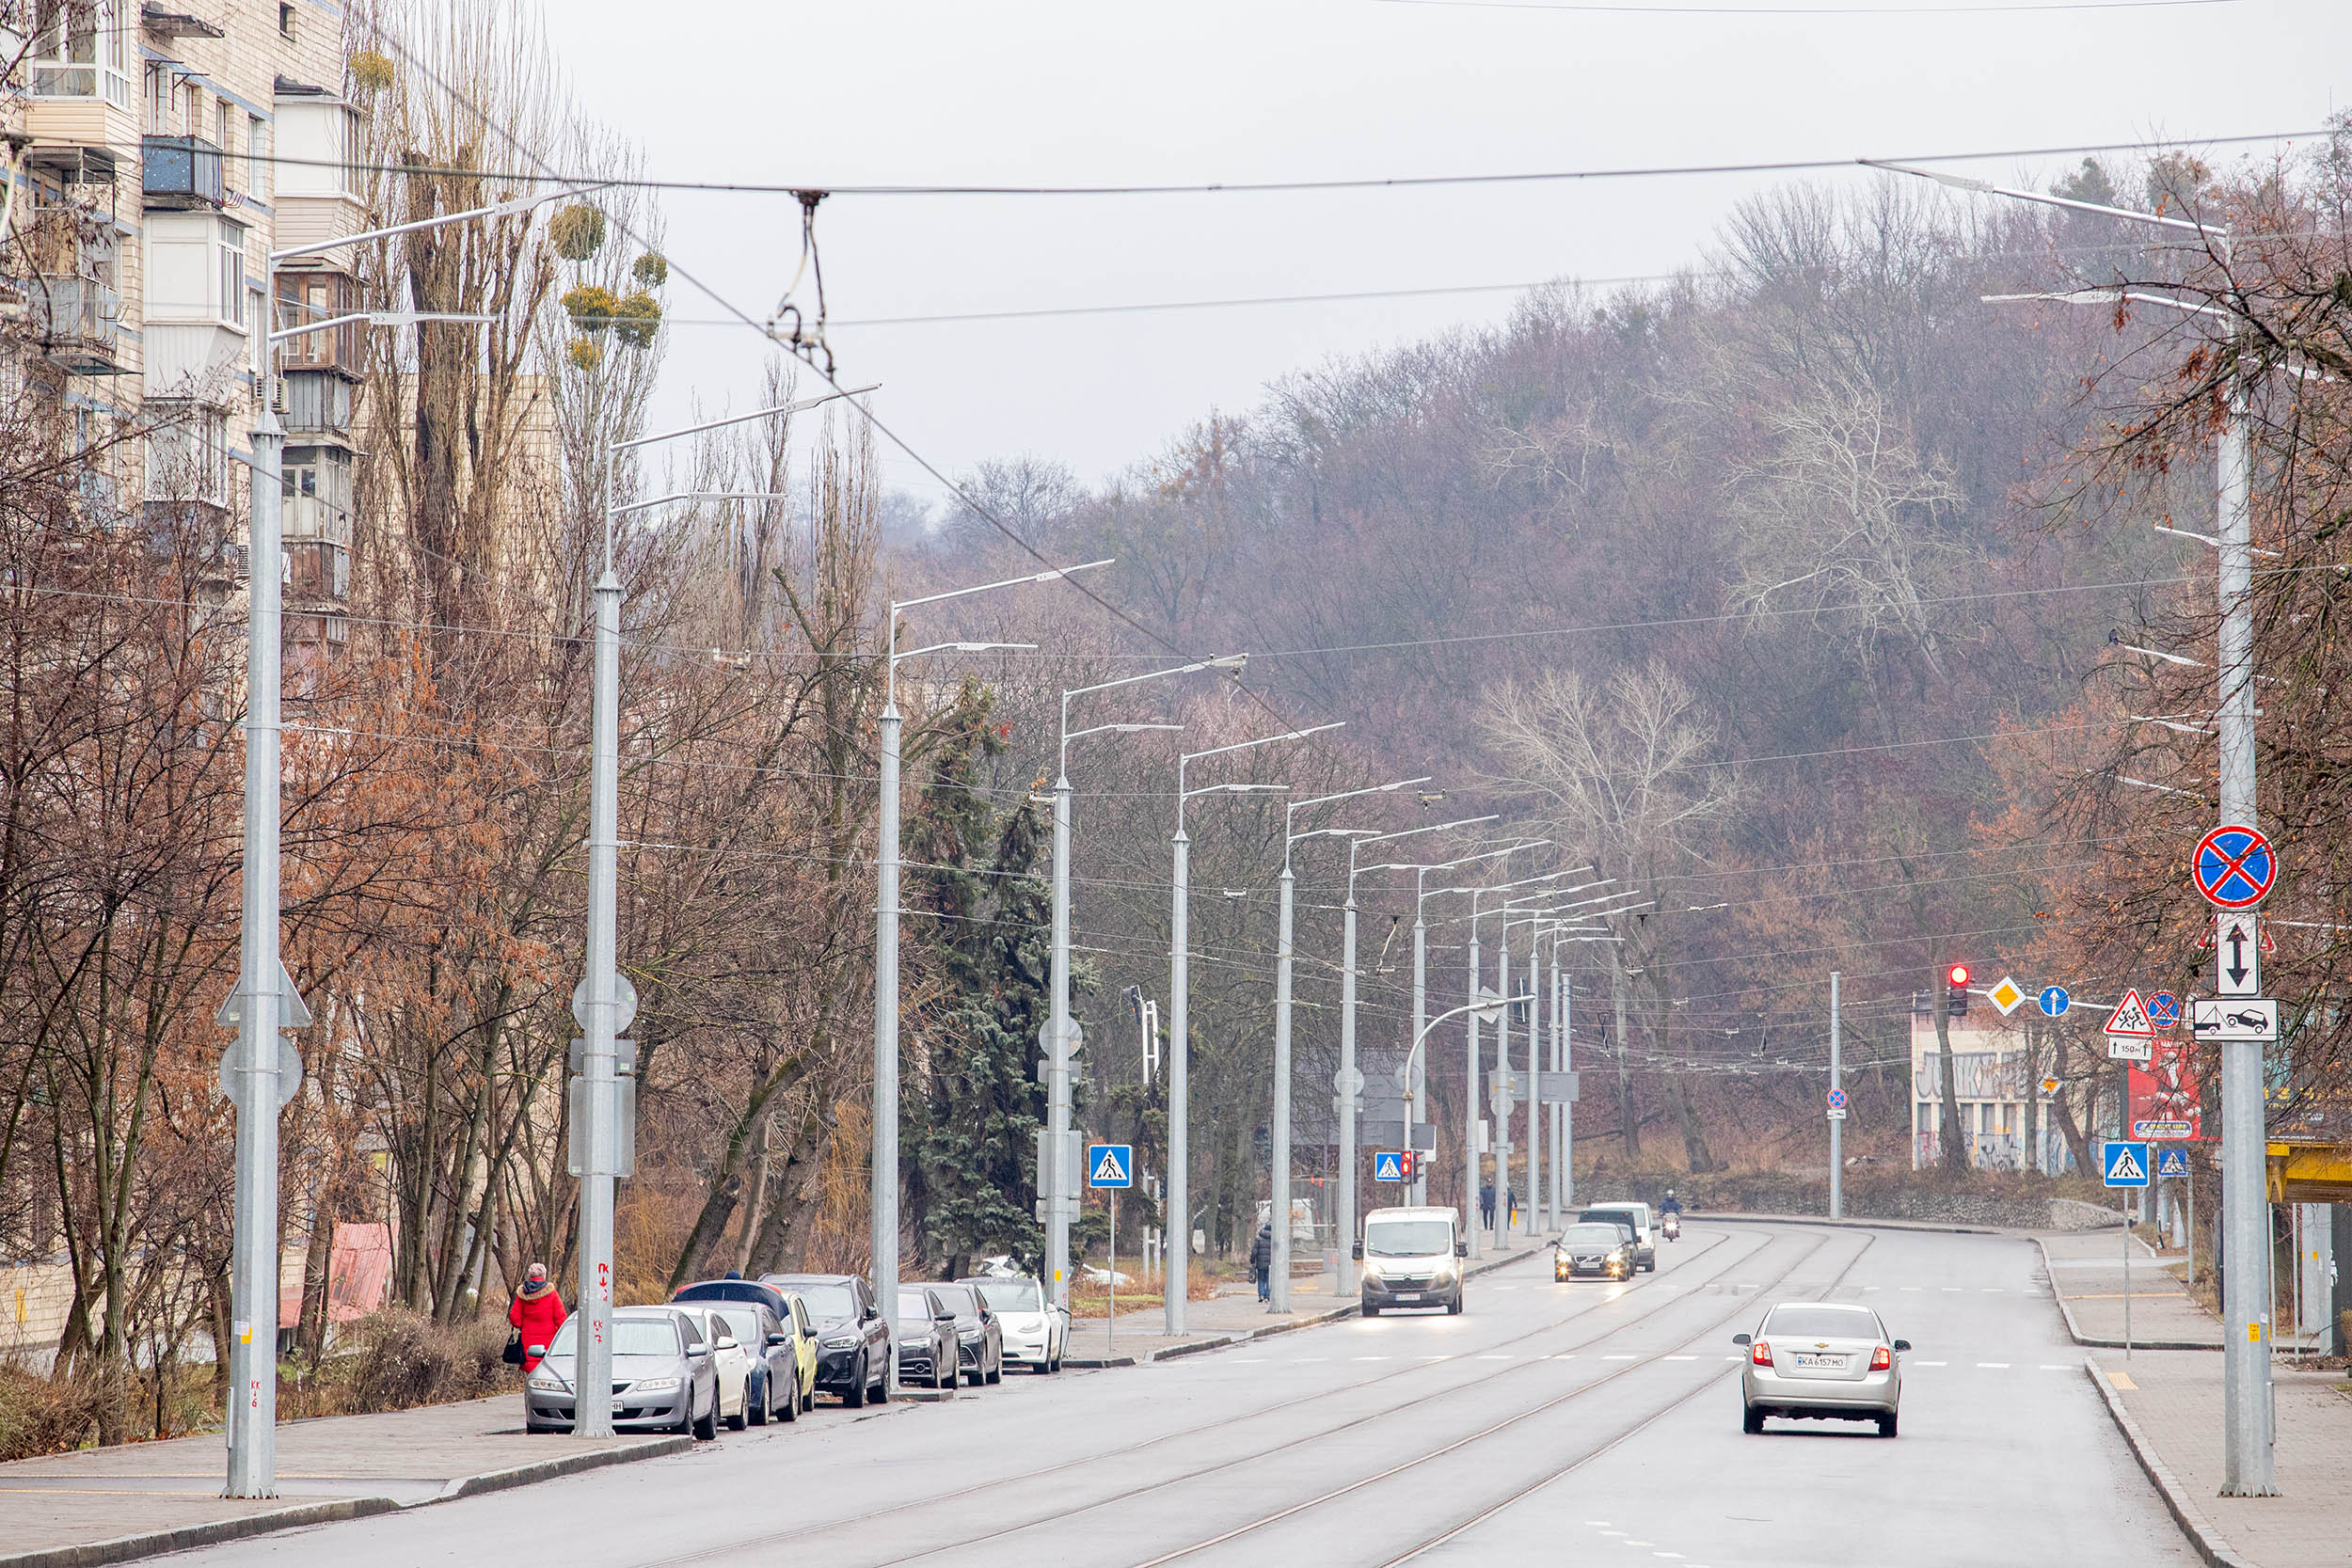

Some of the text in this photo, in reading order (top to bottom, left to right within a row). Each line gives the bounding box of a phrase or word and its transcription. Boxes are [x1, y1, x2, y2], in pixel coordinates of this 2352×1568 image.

[1802, 1357, 1814, 1366] KA
[1814, 1358, 1832, 1367] 6157
[251, 1398, 258, 1408] 6
